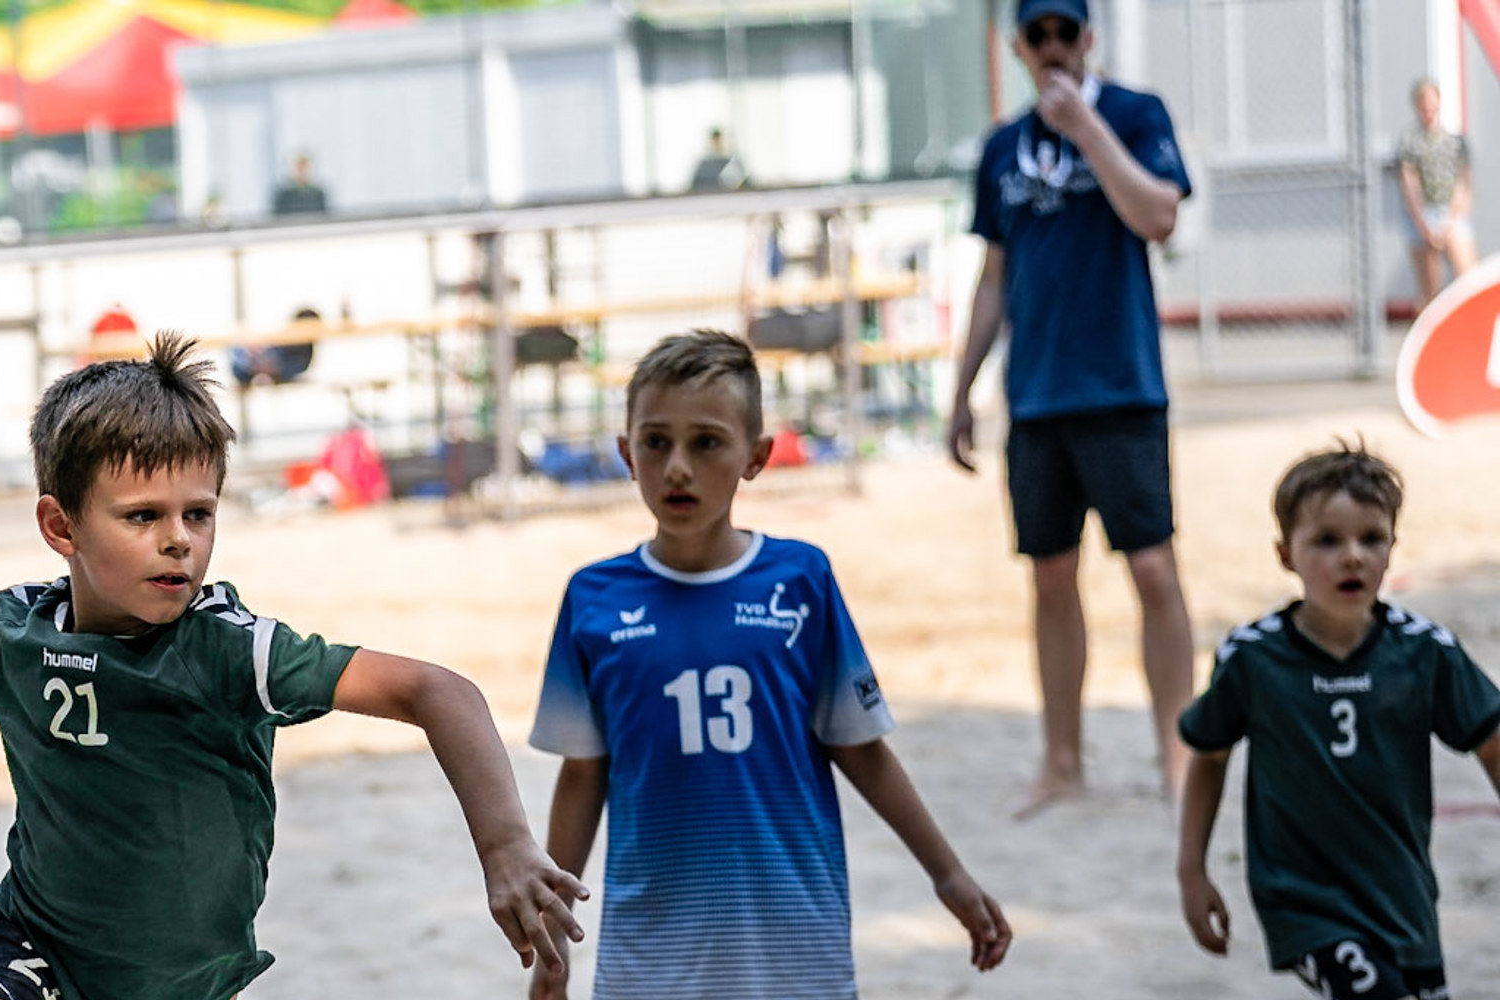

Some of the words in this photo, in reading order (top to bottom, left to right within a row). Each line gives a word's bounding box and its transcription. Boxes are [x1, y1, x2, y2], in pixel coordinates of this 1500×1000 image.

[43, 646, 98, 673] hummel
[1312, 672, 1372, 694] hummel
[43, 676, 109, 747] 21
[663, 664, 754, 756] 13
[1329, 698, 1358, 758] 3
[1334, 940, 1379, 994] 3
